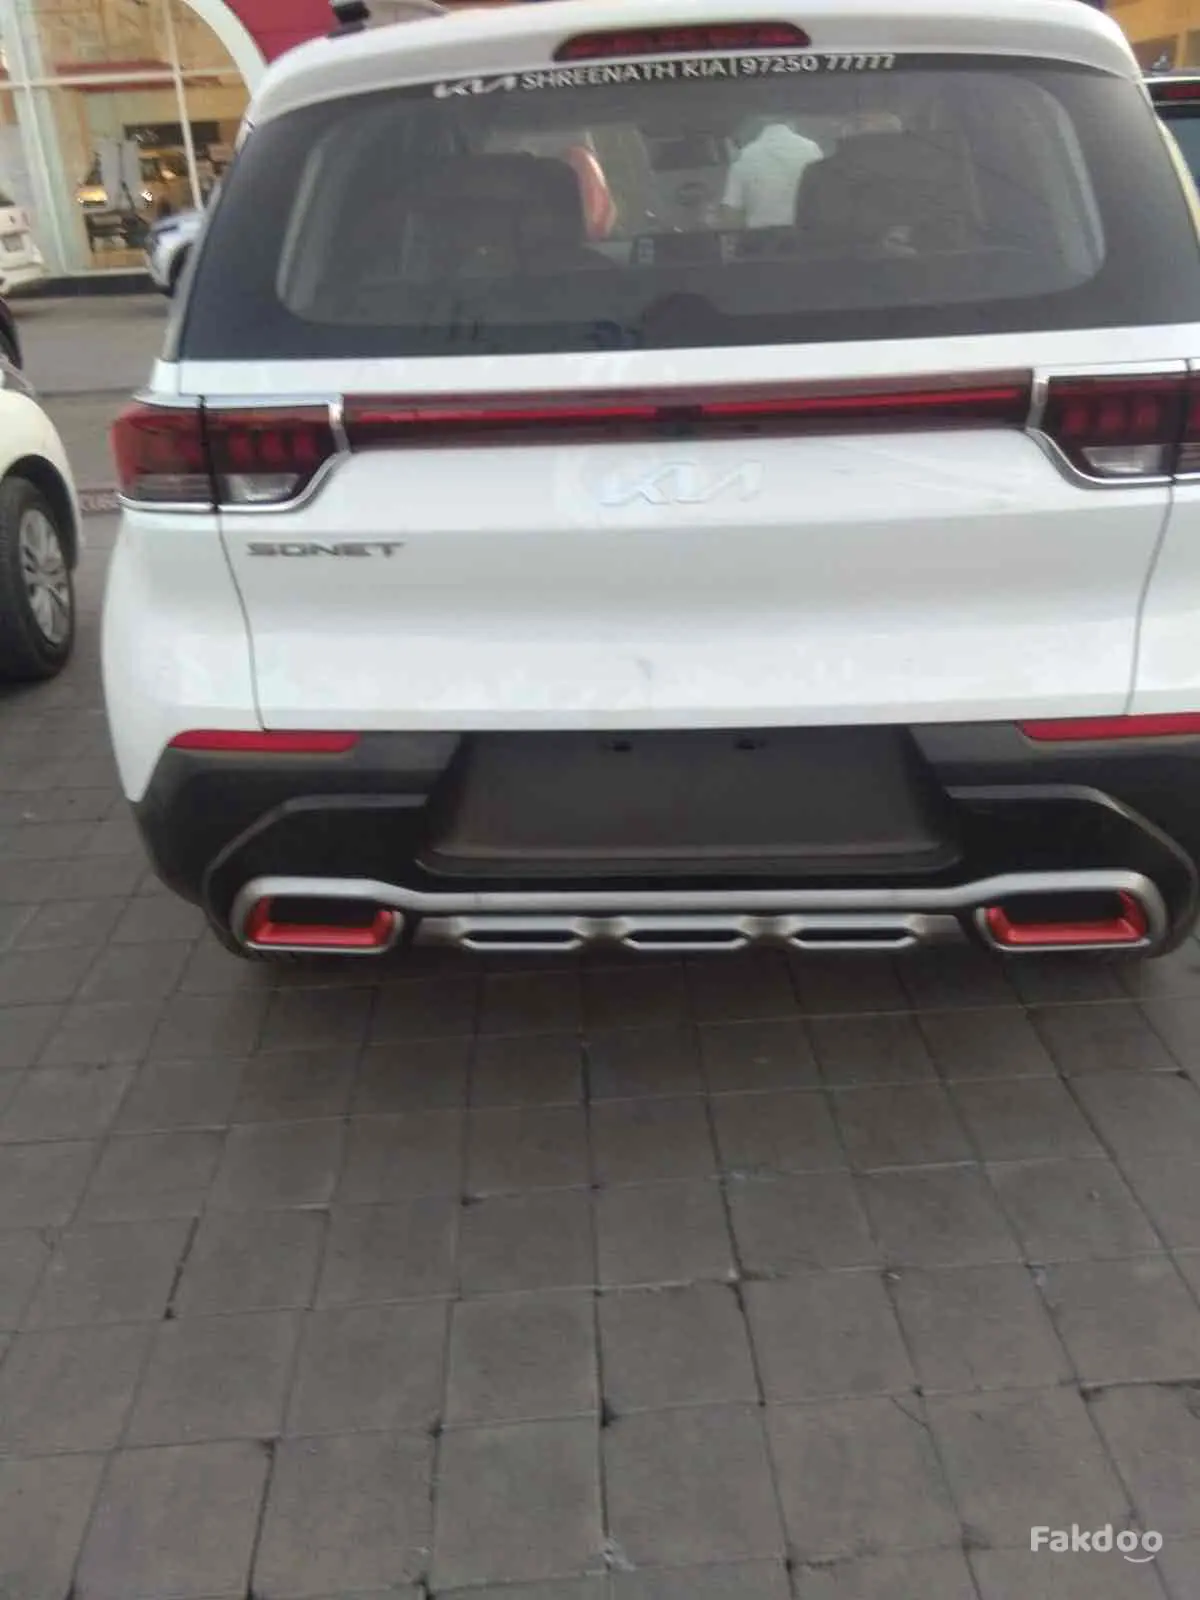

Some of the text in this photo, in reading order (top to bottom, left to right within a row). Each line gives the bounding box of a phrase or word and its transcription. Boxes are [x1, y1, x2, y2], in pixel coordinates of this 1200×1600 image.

[521, 62, 676, 90] SHREENATH
[681, 58, 726, 77] KIA
[741, 55, 818, 75] 97250
[825, 54, 895, 70] 77777
[598, 459, 766, 506] KIA
[247, 542, 404, 557] SONET
